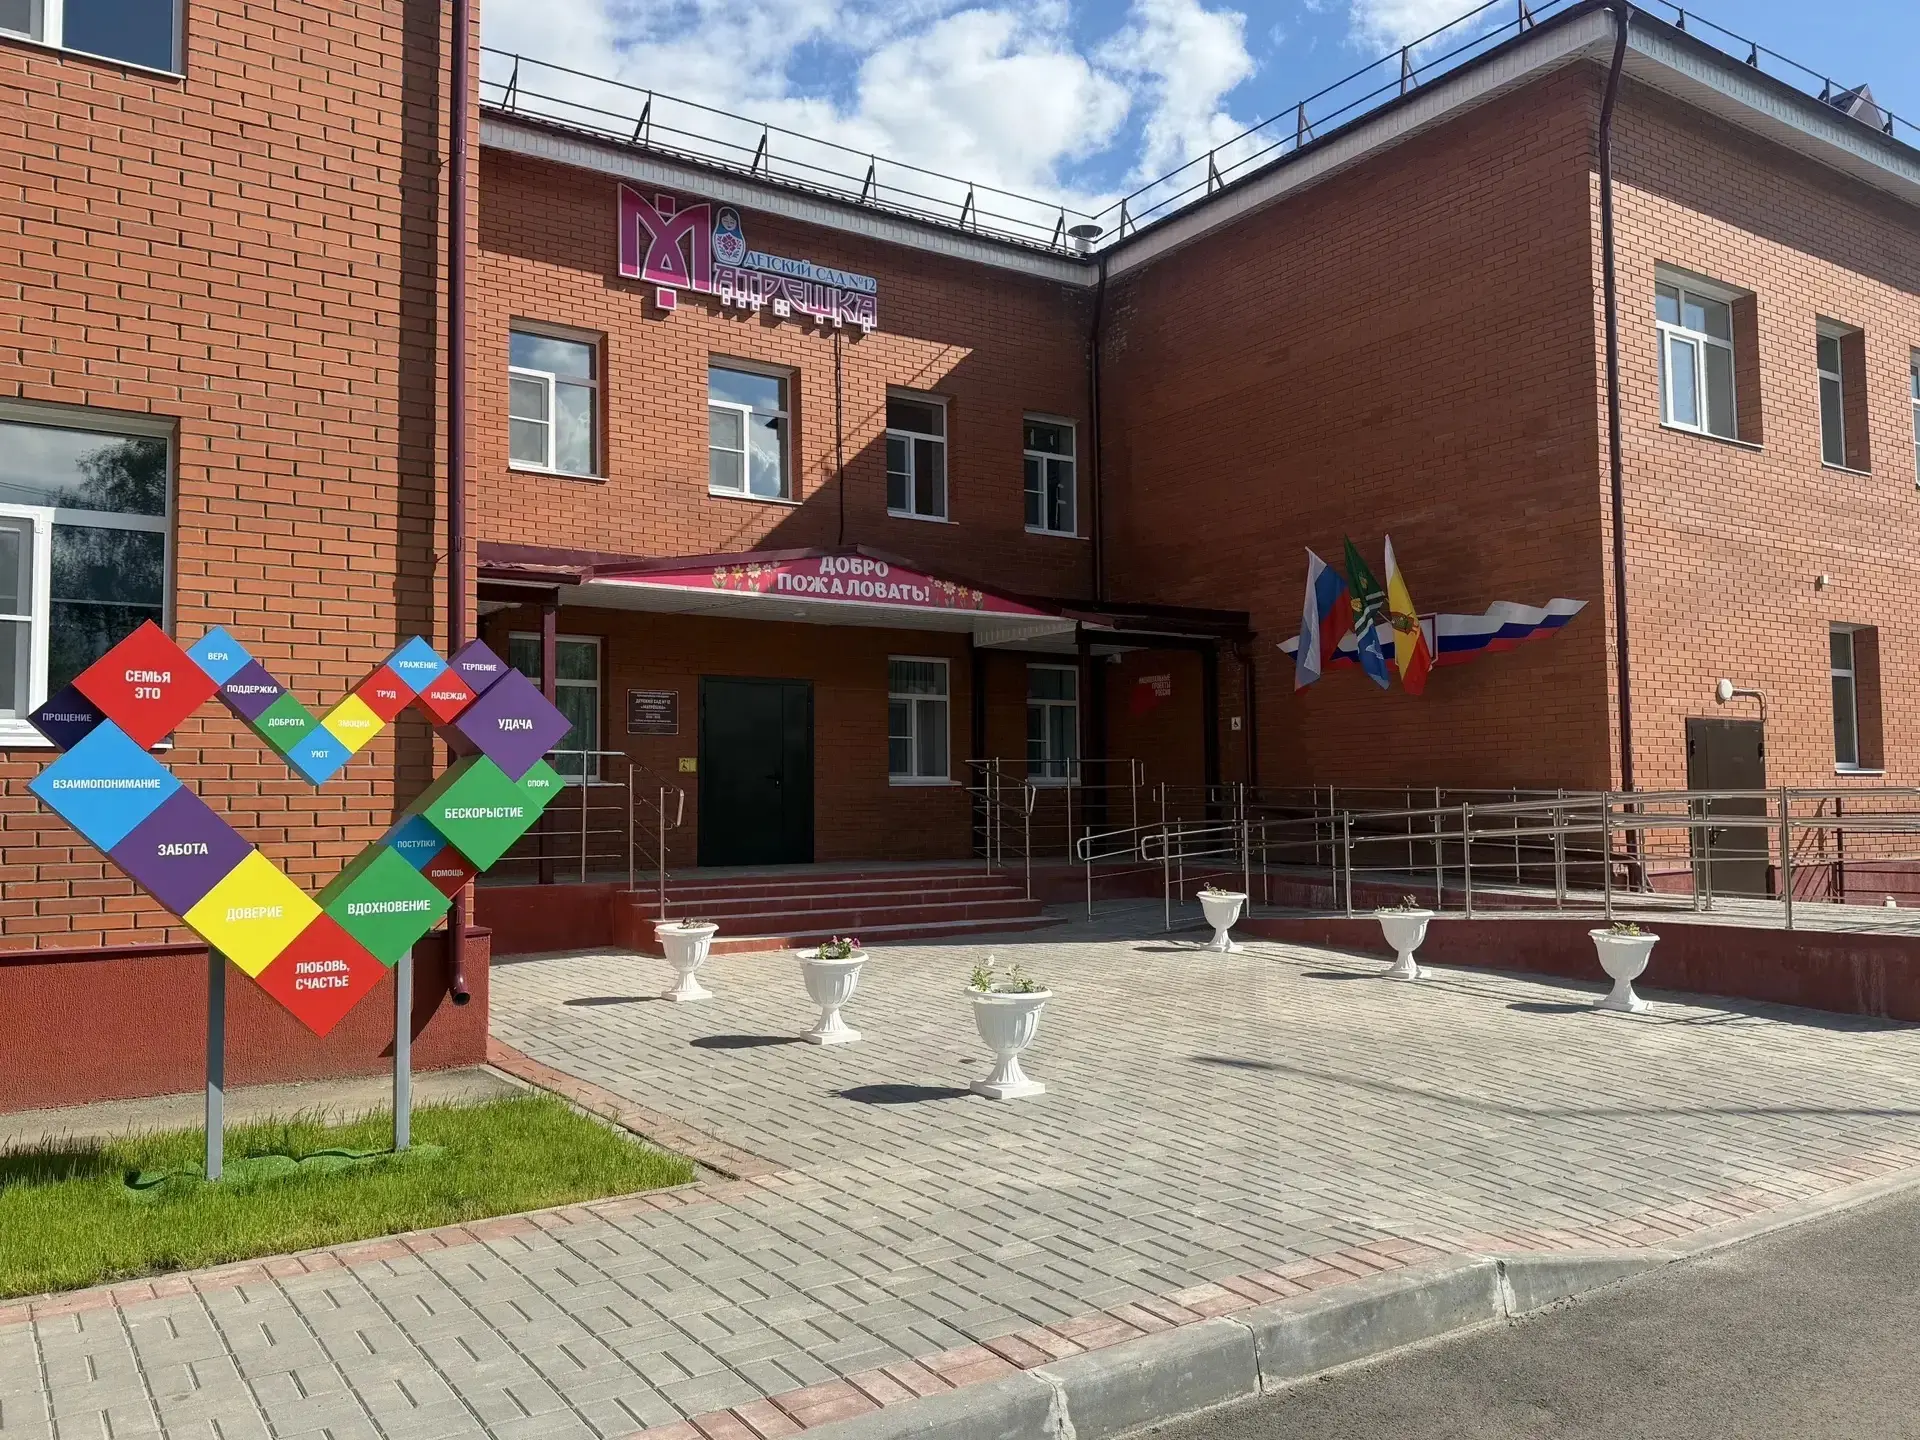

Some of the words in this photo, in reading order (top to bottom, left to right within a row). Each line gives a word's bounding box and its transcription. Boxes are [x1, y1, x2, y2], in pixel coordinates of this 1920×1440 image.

[745, 252, 811, 277] ДЕТСКИЙ
[816, 267, 846, 287] САД
[819, 556, 889, 578] ДОБРО
[777, 573, 930, 602] ПОЖАЛОВАТЬ!
[207, 652, 229, 661] ВЕРА
[399, 660, 438, 669] УВАЖЕНИЕ
[462, 662, 497, 672] ТЕРПЕНИЕ
[125, 669, 171, 684] СЕМЬЯ
[134, 686, 161, 700] ЭТО
[226, 684, 278, 694] ПОДДЕРЖКА
[376, 689, 397, 699] ТРУД
[430, 691, 467, 701] НАДЕЖДА
[42, 712, 92, 722] ПРОЩЕНИЕ
[268, 717, 305, 727] ДОБРОТА
[497, 718, 533, 731] УДАЧА
[310, 750, 329, 759] УЮТ
[52, 778, 161, 789] ВЗАИМОПОНИМАНИЕ
[527, 779, 550, 788] ОПОРА
[444, 806, 524, 819] БЕСКОРЫСТИЕ
[157, 842, 209, 856] ЗАБОТА
[397, 839, 436, 849] ПОСТУПКИ
[431, 868, 464, 878] ПОМОЩЬ
[347, 899, 431, 917] ВДОХНОВЕНИЕ
[225, 906, 283, 922] ДОВЕРИЕ
[295, 959, 350, 974] ЛЮБОВЬ,
[295, 975, 349, 990] СЧАСТЬЕ
